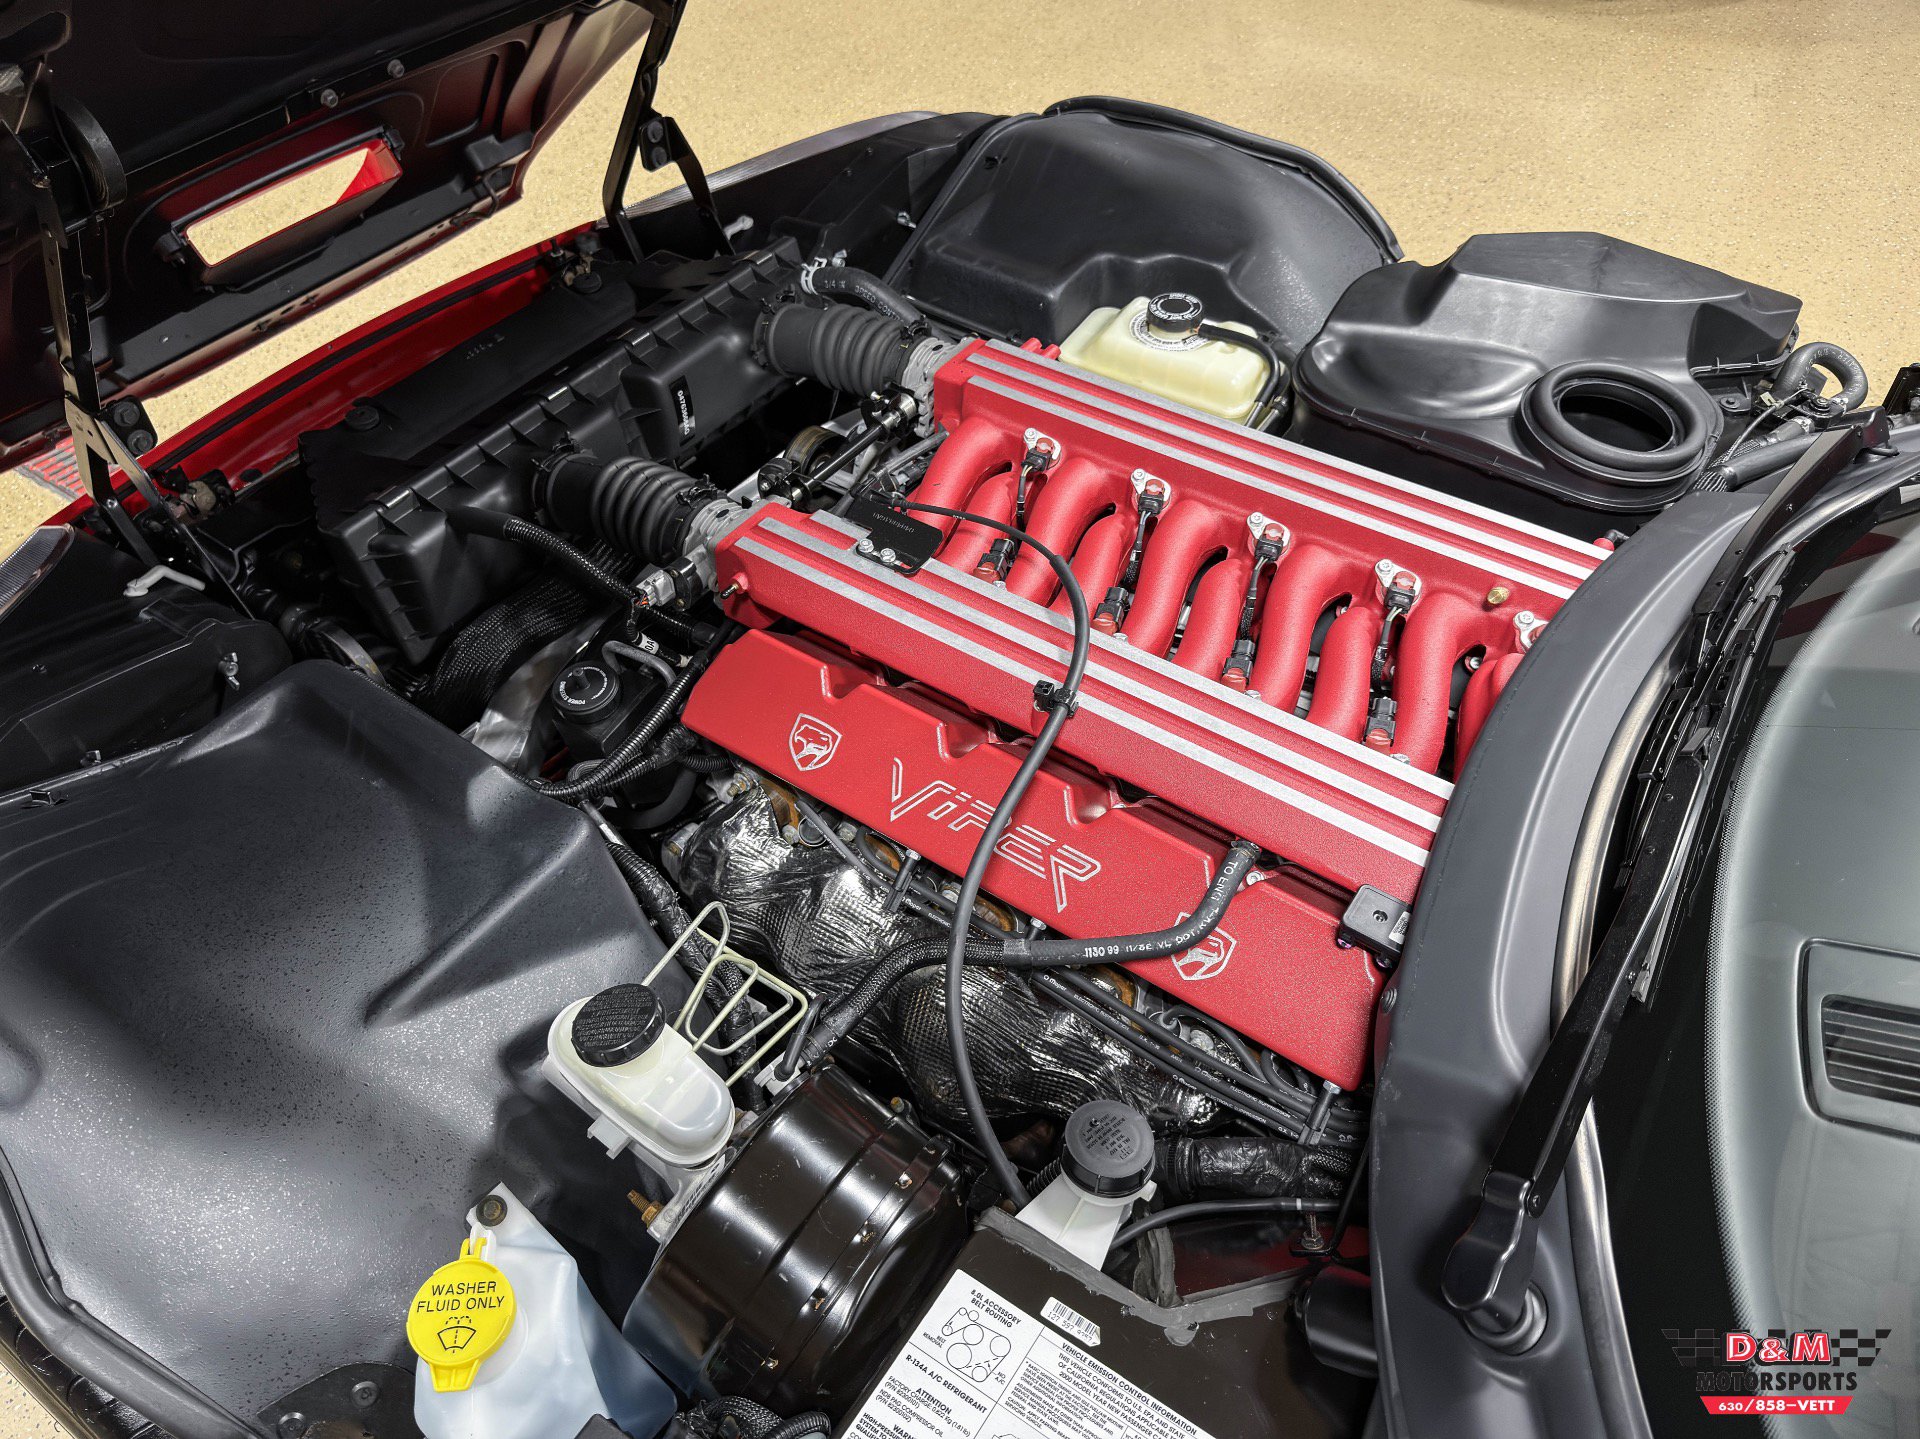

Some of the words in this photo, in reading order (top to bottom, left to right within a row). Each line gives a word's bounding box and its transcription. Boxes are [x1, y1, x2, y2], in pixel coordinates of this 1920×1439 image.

[1223, 861, 1239, 875] TO
[432, 1281, 497, 1296] WASHER
[417, 1299, 460, 1313] FLUID
[466, 1296, 505, 1310] ONLY
[970, 1297, 985, 1309] BELT
[984, 1306, 1013, 1328] ROUTING
[983, 1297, 1021, 1325] ACCESSORY
[1047, 1311, 1060, 1322] 127
[887, 1375, 911, 1394] FACTORY
[905, 1354, 928, 1373] R-134A
[927, 1369, 943, 1383] A/C
[942, 1379, 987, 1414] REFRIGERANT
[994, 1375, 1005, 1385] A/C
[997, 1371, 1006, 1379] NO
[883, 1380, 897, 1392] (P/N
[1057, 1352, 1070, 1363] THIS
[1069, 1359, 1092, 1378] VEHICLE
[1091, 1374, 1124, 1400] CONFORMS
[1123, 1396, 1133, 1405] TO
[1131, 1401, 1144, 1412] U.S.
[1142, 1409, 1155, 1420] EPA
[1154, 1417, 1169, 1429] AND
[1167, 1425, 1185, 1439] STATE
[1061, 1342, 1088, 1363] VEHICLE
[1087, 1359, 1118, 1383] EMISSION
[1117, 1379, 1150, 1405] CONTROL
[1150, 1401, 1197, 1436] INFORMATION
[874, 1393, 888, 1406] (P/N
[915, 1386, 952, 1414] ATTENTION
[1057, 1360, 1067, 1370] OF
[1065, 1366, 1099, 1392] CALIFORNIA
[1098, 1388, 1136, 1417] REGULATIONS
[1135, 1413, 1169, 1439] APPLICABLE
[1058, 1370, 1072, 1382] 2000
[1071, 1379, 1092, 1396] MODEL
[1091, 1392, 1107, 1406] YEAR
[1106, 1402, 1120, 1415] NEW
[1119, 1411, 1153, 1437] PASSENGER
[858, 1417, 879, 1434] SYSTEM
[900, 1404, 935, 1431] COMPRESSOR
[933, 1427, 944, 1437] OIL
